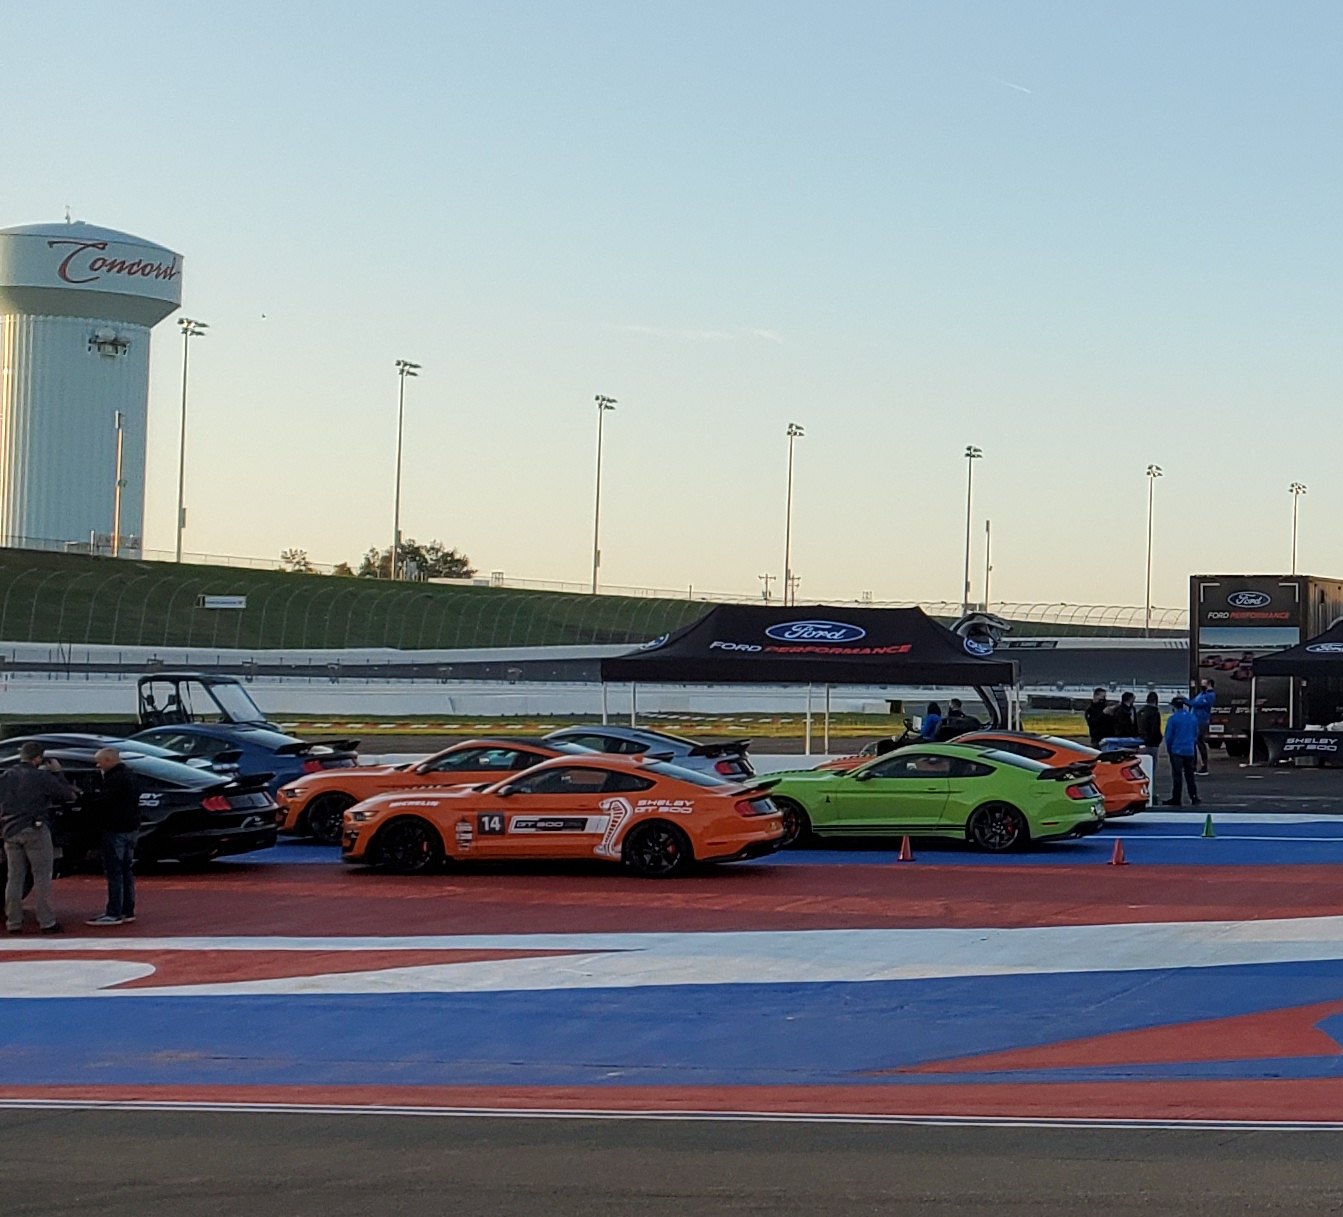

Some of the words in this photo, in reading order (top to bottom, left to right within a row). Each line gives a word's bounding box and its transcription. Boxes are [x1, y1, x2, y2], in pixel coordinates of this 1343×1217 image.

[47, 241, 180, 284] Concord
[1229, 612, 1291, 620] PERFORMANCE
[784, 623, 847, 640] Ford
[709, 641, 763, 652] FORD
[763, 644, 912, 655] PERFORMANCE
[481, 816, 501, 831] 14
